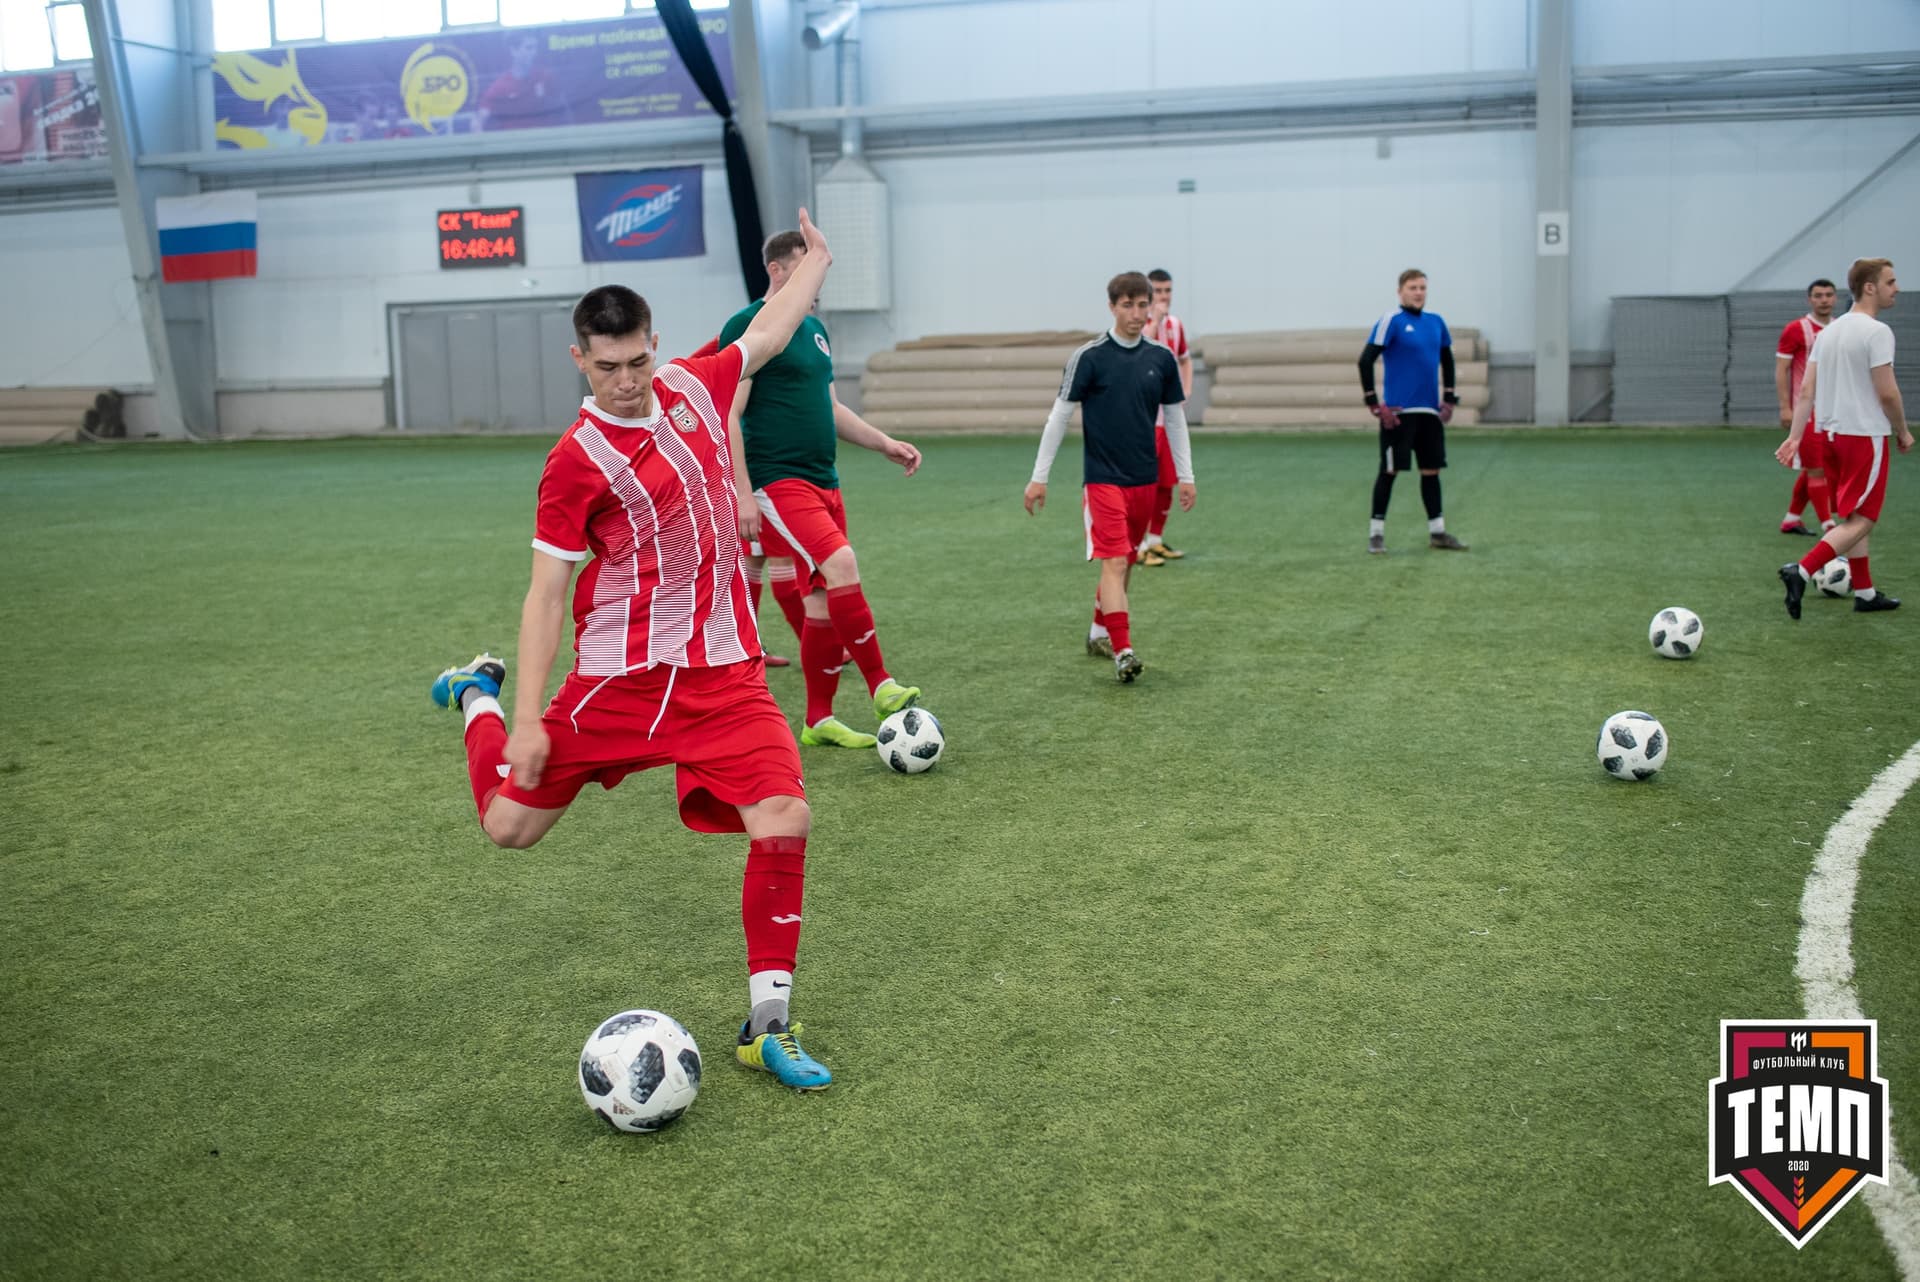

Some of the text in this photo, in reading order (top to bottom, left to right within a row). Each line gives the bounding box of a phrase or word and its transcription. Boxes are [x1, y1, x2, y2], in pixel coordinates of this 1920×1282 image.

[599, 26, 668, 45] побежда
[438, 209, 519, 231] СК "Темп"
[441, 236, 516, 260] 16:46:44
